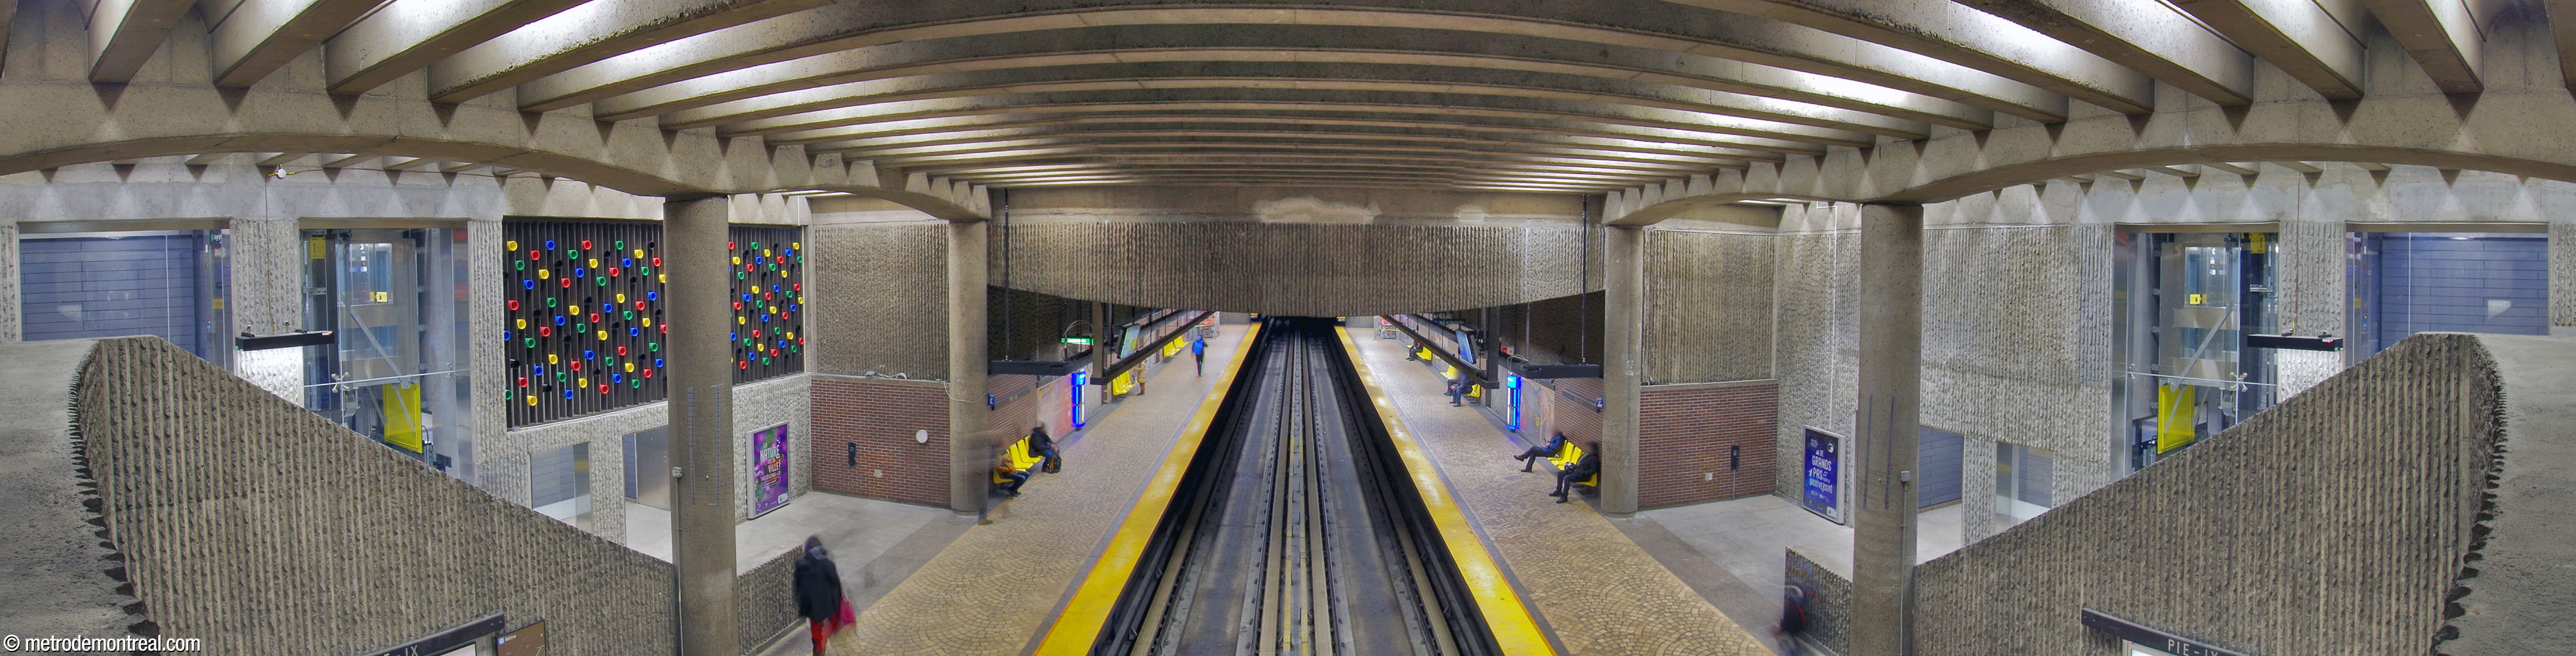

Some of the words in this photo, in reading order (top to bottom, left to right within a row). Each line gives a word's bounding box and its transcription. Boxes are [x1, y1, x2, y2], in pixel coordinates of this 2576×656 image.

[760, 445, 780, 462] NATURE
[1812, 455, 1832, 472] GRANDS
[1813, 467, 1823, 480] PAS
